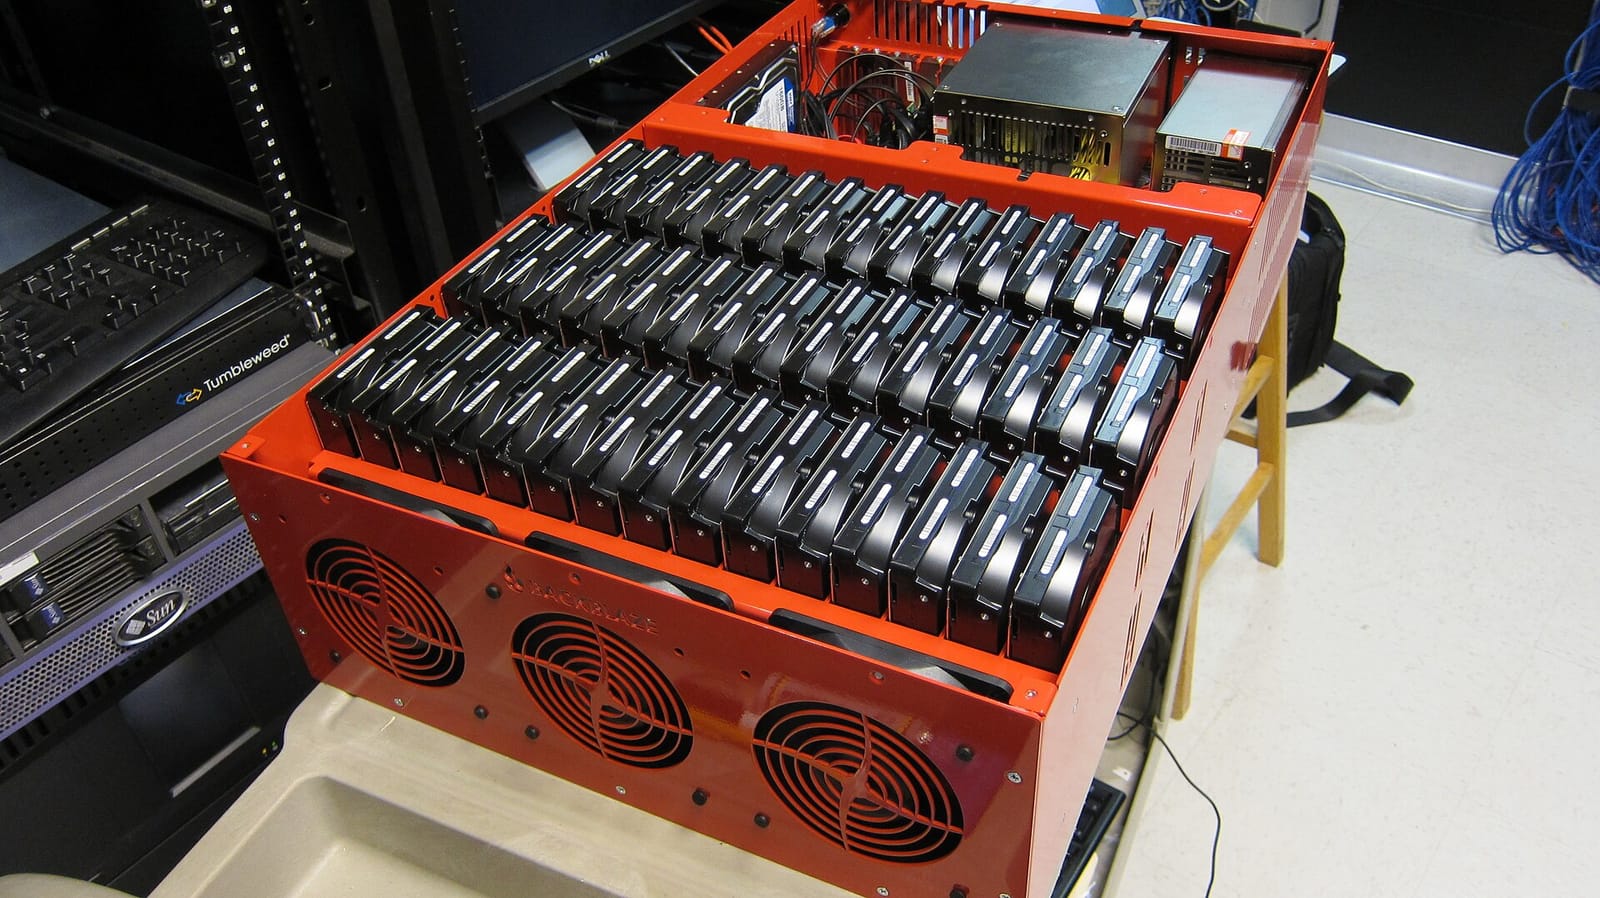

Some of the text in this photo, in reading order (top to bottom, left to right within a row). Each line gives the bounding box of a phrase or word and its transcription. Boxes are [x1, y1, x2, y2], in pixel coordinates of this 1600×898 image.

[588, 50, 611, 68] DELL
[256, 103, 264, 113] 64
[203, 334, 290, 392] Tumbleweed
[146, 599, 176, 627] Sun
